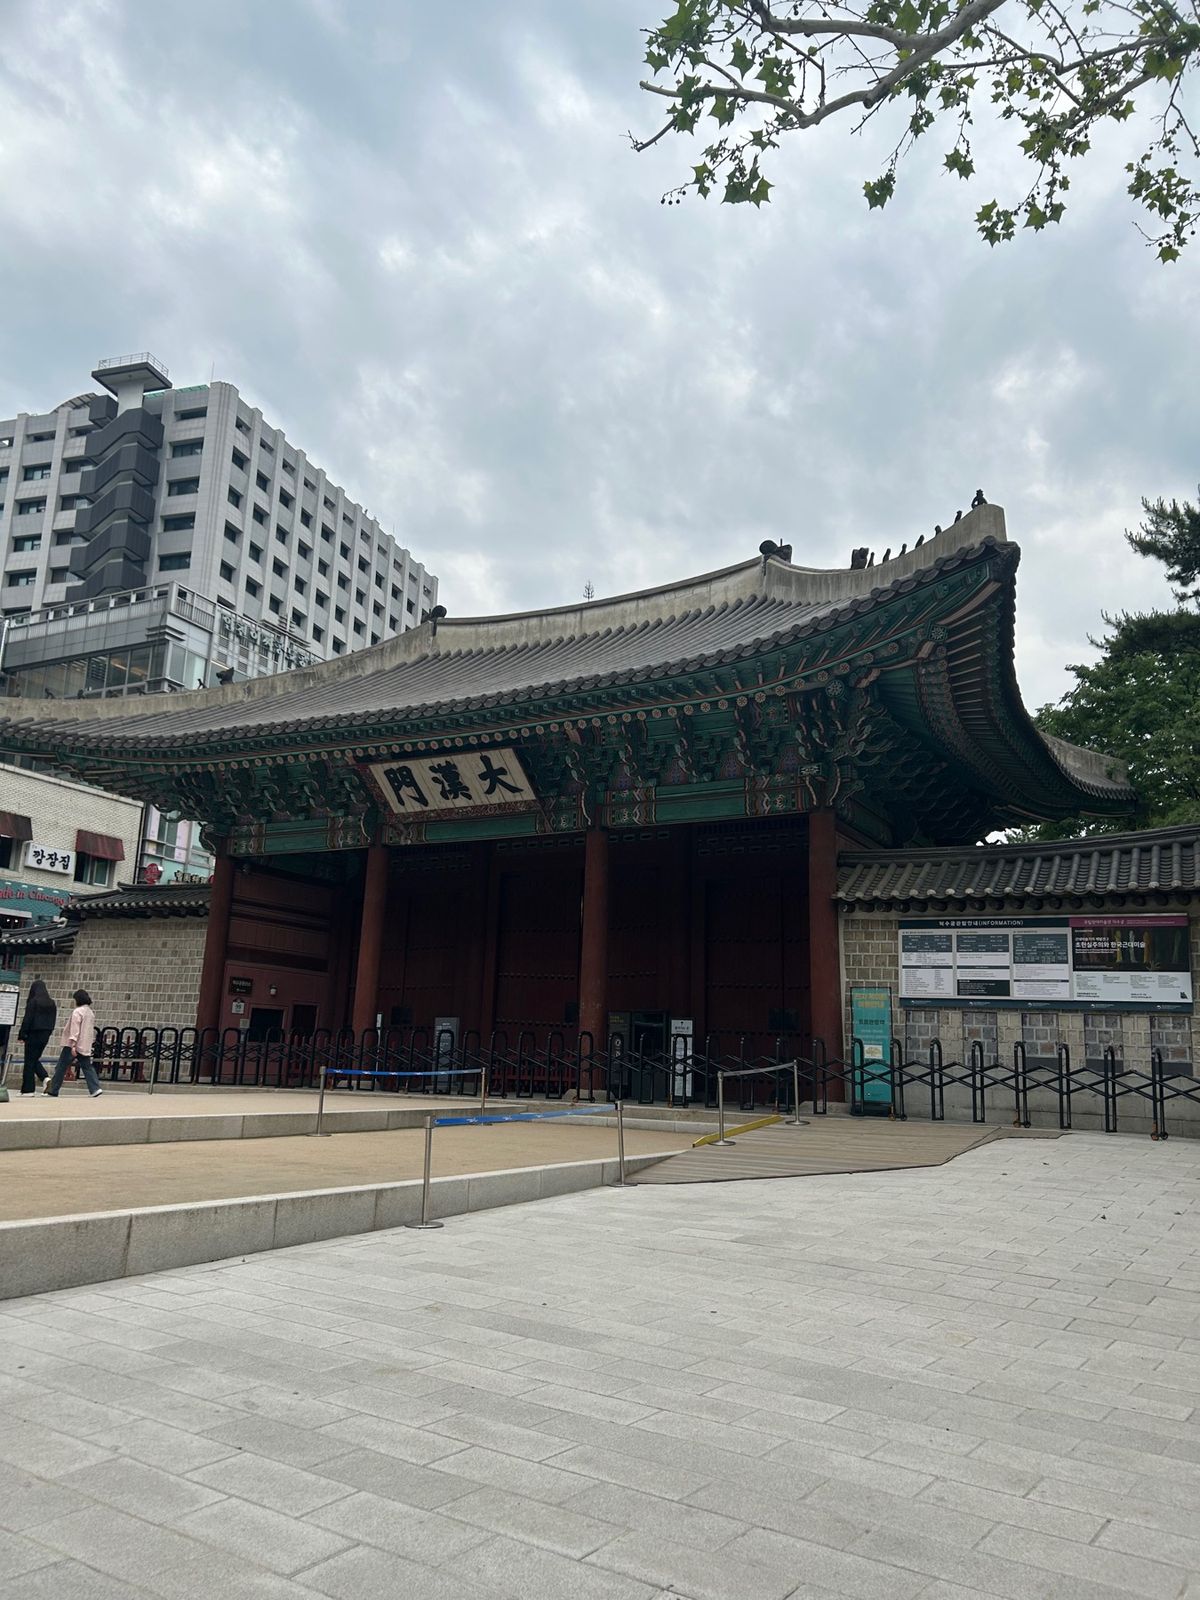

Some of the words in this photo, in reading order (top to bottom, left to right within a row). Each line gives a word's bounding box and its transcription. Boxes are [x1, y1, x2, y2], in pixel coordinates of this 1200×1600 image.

[383, 754, 524, 808] 大漢門
[32, 848, 71, 870] 깡장집
